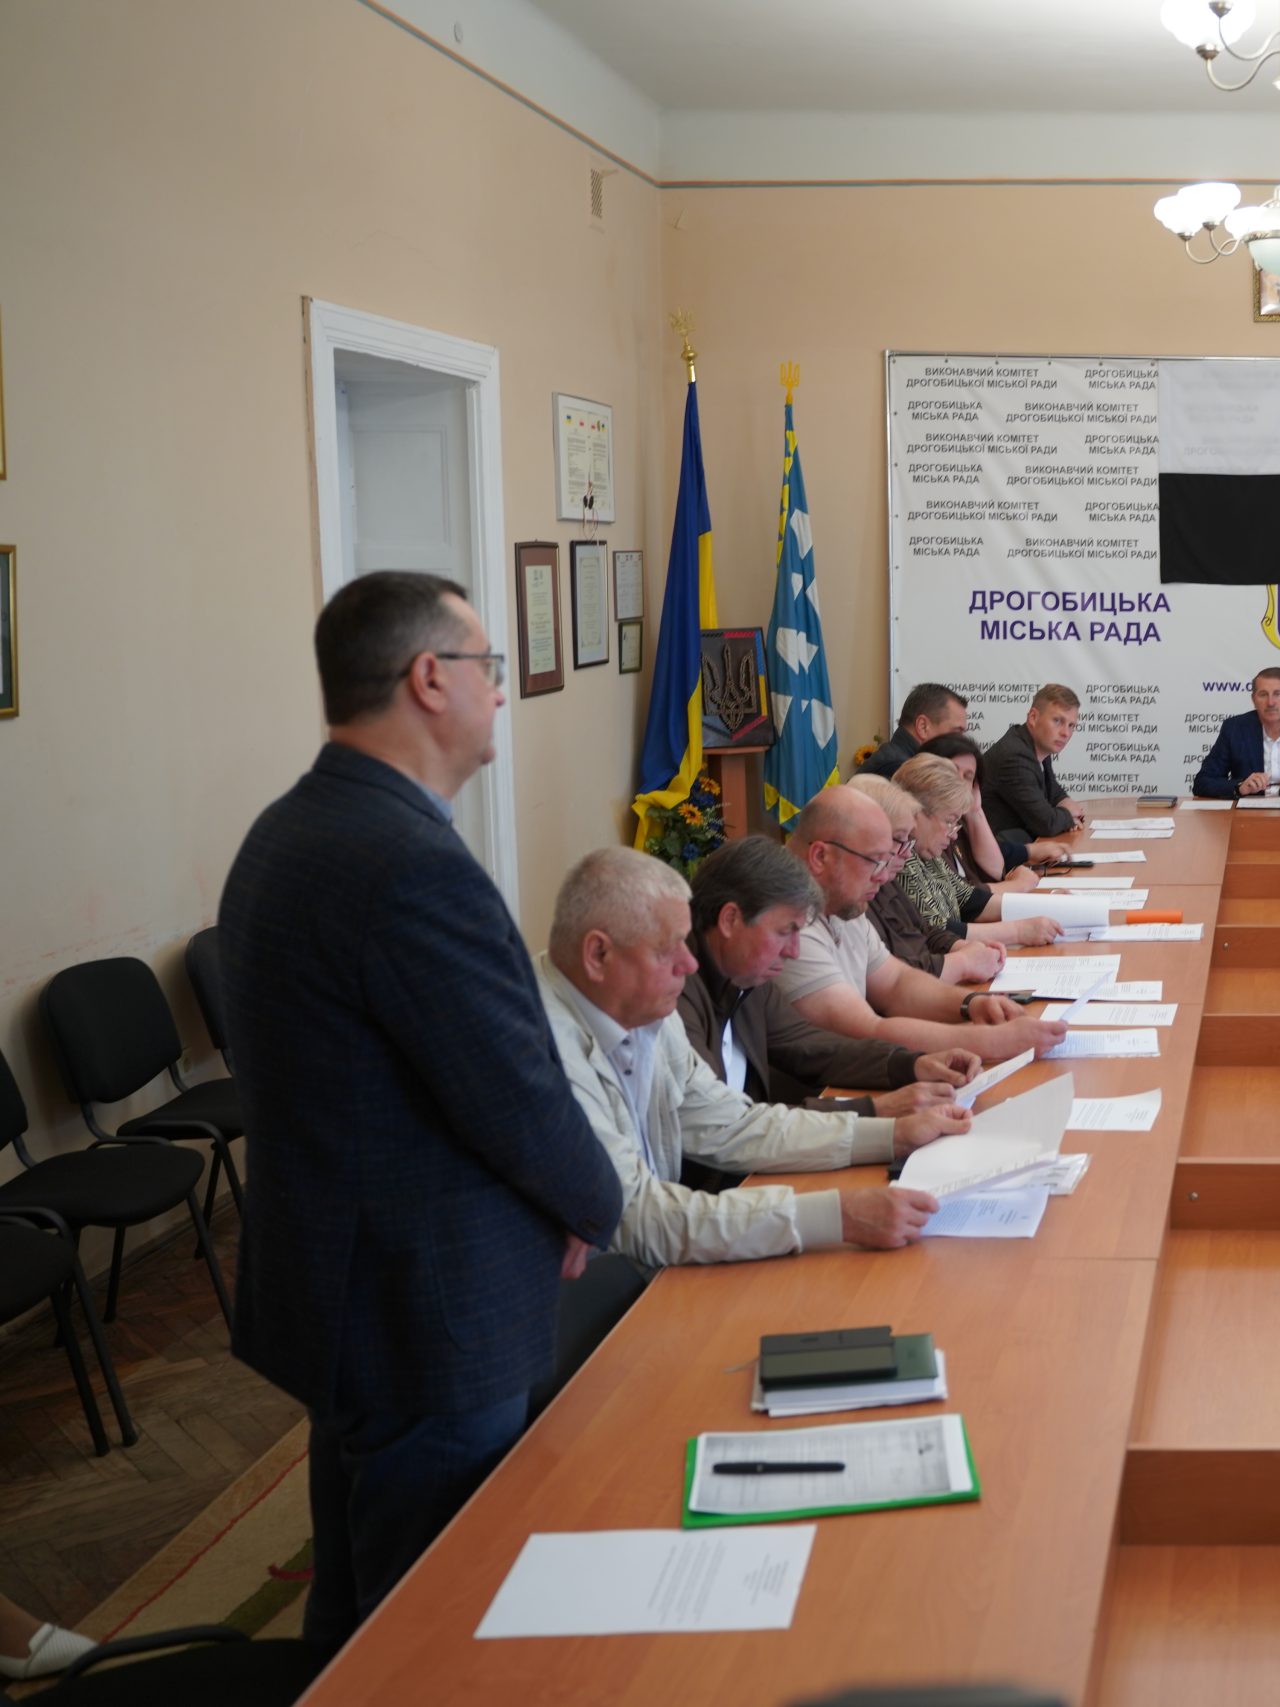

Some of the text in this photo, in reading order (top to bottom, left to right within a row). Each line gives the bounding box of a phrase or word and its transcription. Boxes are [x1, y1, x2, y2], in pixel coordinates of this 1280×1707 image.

[925, 367, 1038, 378] ВИКОНАВЧИЙ КОМІТЕТ
[1085, 369, 1158, 379] ДРОГОБИЦЬКА
[907, 378, 1057, 390] ДРОГОБИЦЬКОЇ МІСЬКОЇ РАДИ
[1089, 380, 1155, 391] МІСЬКА РАДА
[908, 401, 982, 411] ДРОГОБИЦЬКА
[1025, 402, 1138, 413] ВИКОНАВЧИЙ КОМІТЕТ
[912, 411, 978, 422] МІСЬКА РАДА
[1006, 413, 1157, 425] ДРОГОБИЦЬКОЇ МІСЬКОЇ РАДИ
[926, 433, 1039, 443] ВИКОНАВЧИЙ КОМІТЕТ
[1085, 435, 1158, 445] ДРОГОБИЦЬКА
[907, 444, 1057, 456] ДРОГОБИЦЬКОЇ МІСЬКОЇ РАДИ
[1089, 445, 1155, 456] МІСЬКА РАДА
[909, 463, 983, 473] ДРОГОБИЦЬКА
[1025, 465, 1138, 475] ВИКОНАВЧИЙ КОМІТЕТ
[913, 474, 979, 485] МІСЬКА РАДА
[1007, 476, 1157, 487] ДРОГОБИЦЬКОЇ МІСЬКОЇ РАДИ
[926, 500, 1039, 511] ВИКОНАВЧИЙ КОМІТЕТ
[1085, 502, 1158, 512] ДРОГОБИЦЬКА
[907, 511, 1057, 523] ДРОГОБИЦЬКОЇ МІСЬКОЇ РАДИ
[1089, 513, 1155, 524] МІСЬКА РАДА
[909, 536, 983, 546] ДРОГОБИЦЬКА
[1026, 538, 1138, 548] ВИКОНАВЧИЙ КОМІТЕТ
[914, 547, 980, 558] МІСЬКА РАДА
[1008, 549, 1157, 560] ДРОГОБИЦЬКОЇ МІСЬКОЇ РАДИ
[969, 591, 1171, 613] ДРОГОБИЦЬКА
[981, 621, 1160, 645] МІСЬКА РАДА
[943, 682, 1040, 693] ОНАВЧИЙ КОМІТЕТ
[1086, 684, 1160, 694] ДРОГОБИЦЬКА
[1090, 695, 1156, 706] МІСЬКА РАДА
[1097, 713, 1139, 722] КОМІТЕТ
[1088, 723, 1128, 733] МІСЬКОЇ
[1132, 725, 1157, 735] РАДИ
[1188, 724, 1220, 734] МІСЬК
[1086, 742, 1160, 752] ДРОГОБИЦЬКА
[1090, 753, 1156, 764] МІСЬКА РАДА
[1056, 772, 1139, 783] НАВЧИЙ КОМІТЕТ
[1088, 783, 1129, 793] МІСЬКОЇ
[1131, 785, 1157, 795] РАДИ
